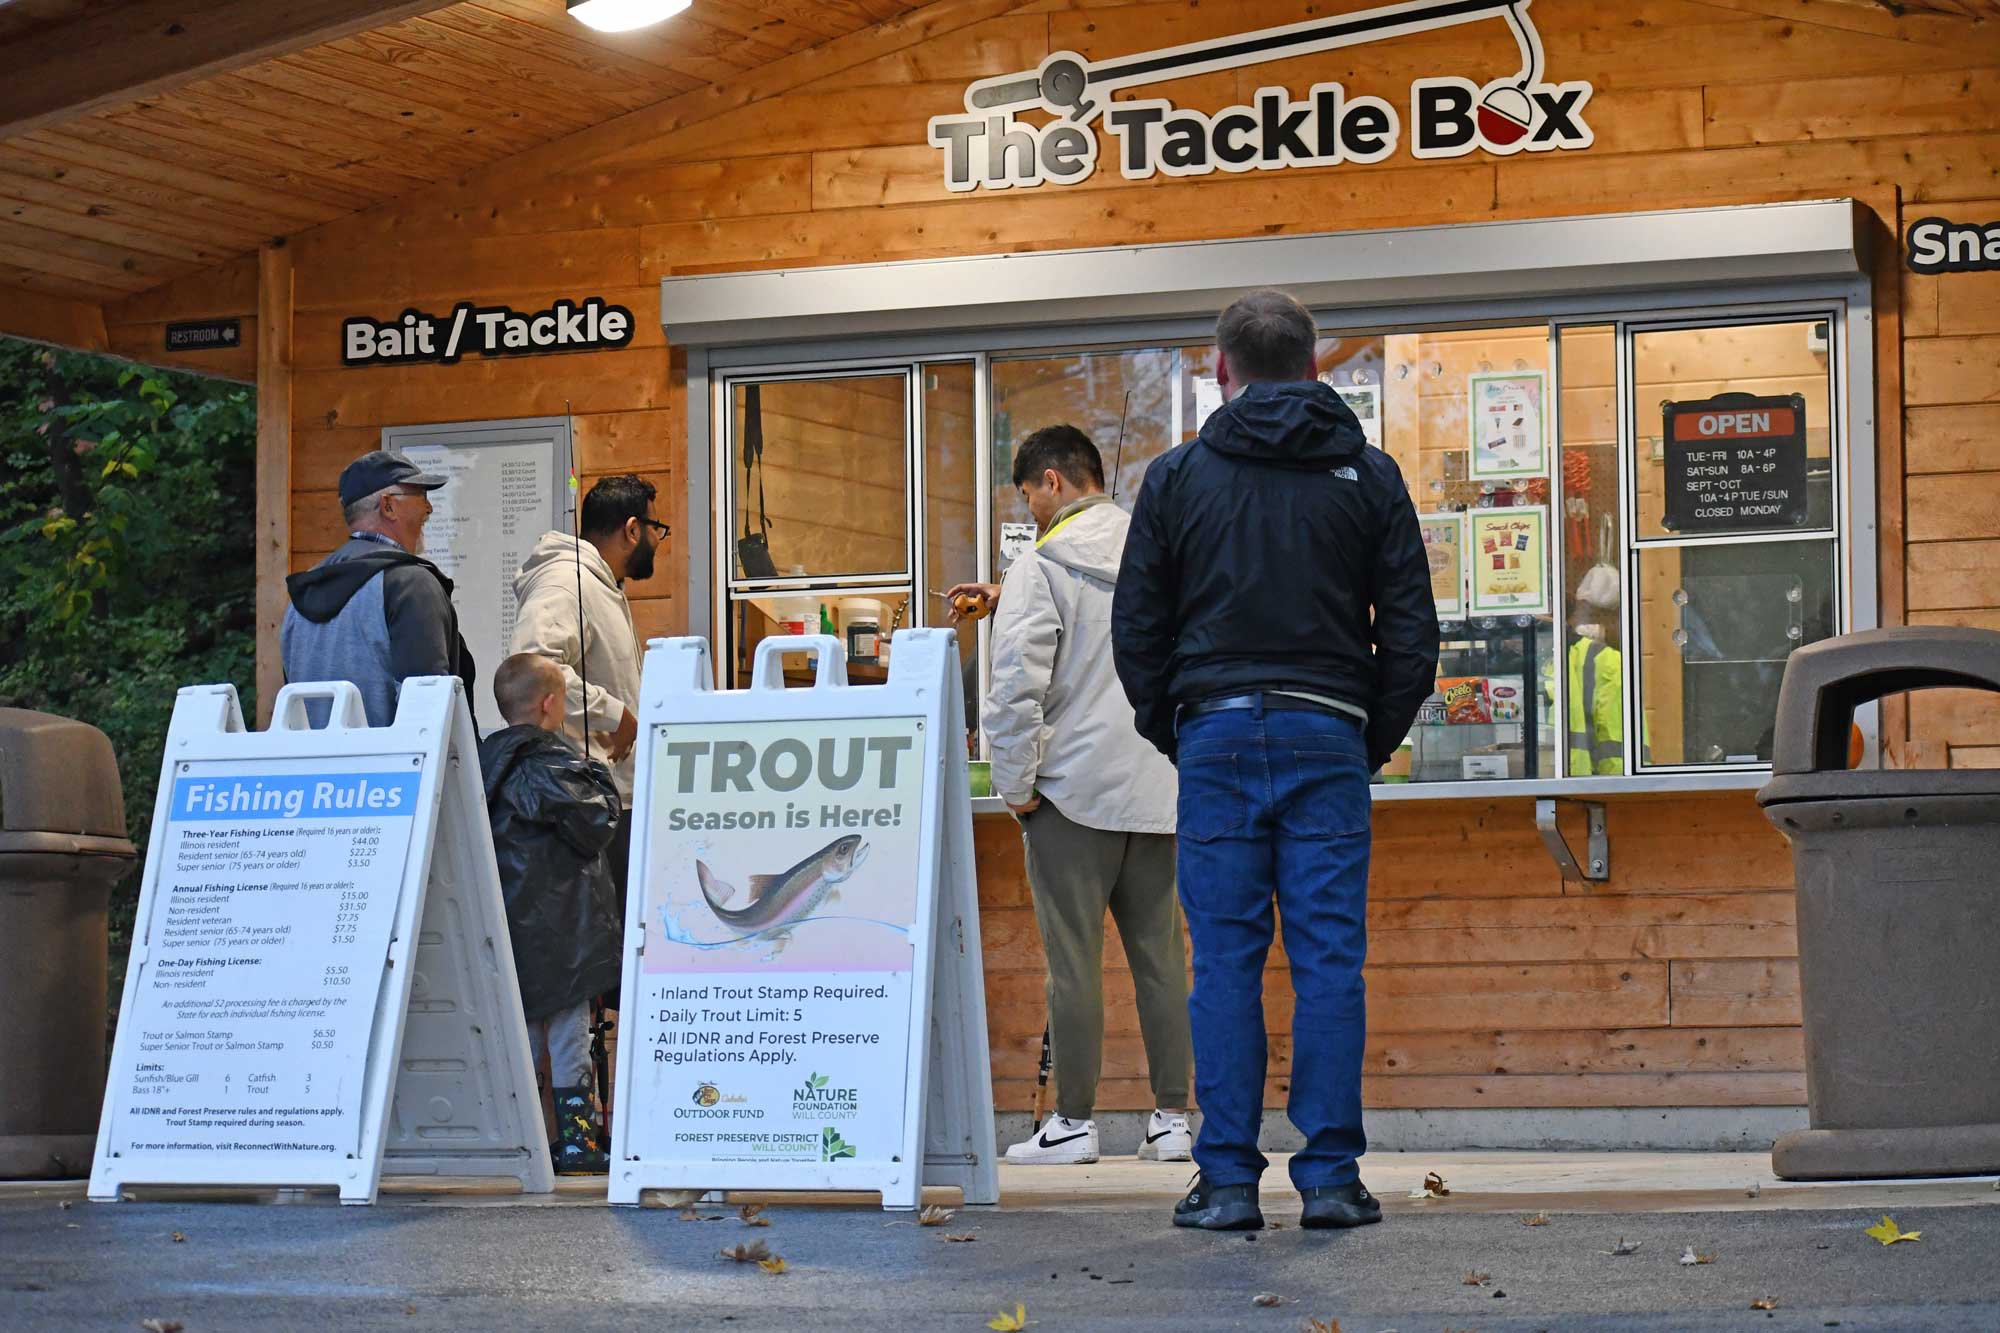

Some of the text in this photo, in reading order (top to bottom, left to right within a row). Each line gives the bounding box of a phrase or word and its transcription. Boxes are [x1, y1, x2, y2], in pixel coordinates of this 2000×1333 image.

[935, 83, 1584, 183] The Tackle Box
[171, 328, 219, 343] RESTROOM
[347, 314, 435, 359] Bait
[476, 303, 628, 349] Tackle
[1698, 413, 1769, 435] OPEN
[1695, 505, 1781, 517] CLOSED MONDAY
[1444, 682, 1472, 704] Cheeto
[667, 736, 912, 793] TROUT
[186, 780, 402, 817] Fishing Rules
[668, 802, 901, 831] Season is Here!
[182, 828, 294, 838] Three-Year Fishing License
[180, 836, 379, 849] Illinois resident $44.00
[178, 848, 376, 860] Resident senior (65-74 years old) $22.25
[176, 862, 200, 872] Super
[200, 862, 225, 872] senior
[228, 861, 241, 871] (75
[242, 862, 264, 872] years
[276, 860, 300, 869] older)
[347, 858, 370, 868] $3.50
[172, 883, 268, 893] Annual Fishing License
[170, 891, 368, 905] Illinois resident $15.00
[168, 902, 366, 914] Non-resident $31.50
[166, 916, 200, 925] Resident
[336, 913, 359, 922] $7.75
[164, 923, 356, 936] Resident senior (65-74 years old) $7.75
[162, 939, 185, 948] Super
[186, 938, 210, 946] senior
[213, 937, 226, 946] (75
[227, 938, 249, 947] years
[260, 936, 285, 944] older)
[331, 935, 354, 944] $1.50
[158, 957, 262, 968] One-Day Fishing License:
[155, 966, 348, 978] Illinois resident $5.50
[661, 984, 887, 1001] Inland Trout Stamp Required.
[659, 1007, 802, 1025] Daily Trout Limit: 5
[142, 1031, 163, 1040] Trout
[175, 1030, 205, 1039] Salmon
[206, 1030, 233, 1040] Stamp
[313, 1029, 335, 1038] $6.50
[657, 1031, 879, 1044] All IDNR and Forest Preserve
[139, 1042, 163, 1052] Super
[164, 1041, 190, 1050] Senior
[192, 1041, 213, 1050] Trout
[226, 1041, 255, 1050] Salmon
[257, 1041, 284, 1051] Stamp
[311, 1040, 333, 1049] $0.50
[654, 1048, 796, 1065] Regulations Apply.
[136, 1063, 164, 1071] Limits:
[133, 1072, 311, 1083] Sunfish/Blue Gill 6 Catfish 3
[132, 1084, 310, 1094] Bass 18"+ 1 Trout 5
[793, 1087, 857, 1101] NATURE
[141, 1107, 160, 1115] IDNR
[178, 1107, 201, 1115] Forest
[274, 1107, 318, 1116] regulations
[320, 1106, 344, 1116] apply.
[792, 1102, 857, 1110] FOUNDATION
[732, 1109, 764, 1118] FUND
[817, 1111, 857, 1119] COUNTY
[166, 1118, 186, 1126] Trout
[188, 1118, 212, 1128] Stamp
[214, 1118, 247, 1127] required
[248, 1118, 274, 1128] during
[675, 1133, 819, 1142] FOREST PRESERVE DISTRICT
[166, 1142, 214, 1150] information,
[216, 1142, 232, 1150] visit
[233, 1142, 336, 1152] ReconnectWithNature.org.
[752, 1144, 817, 1152] WILL COUNTY
